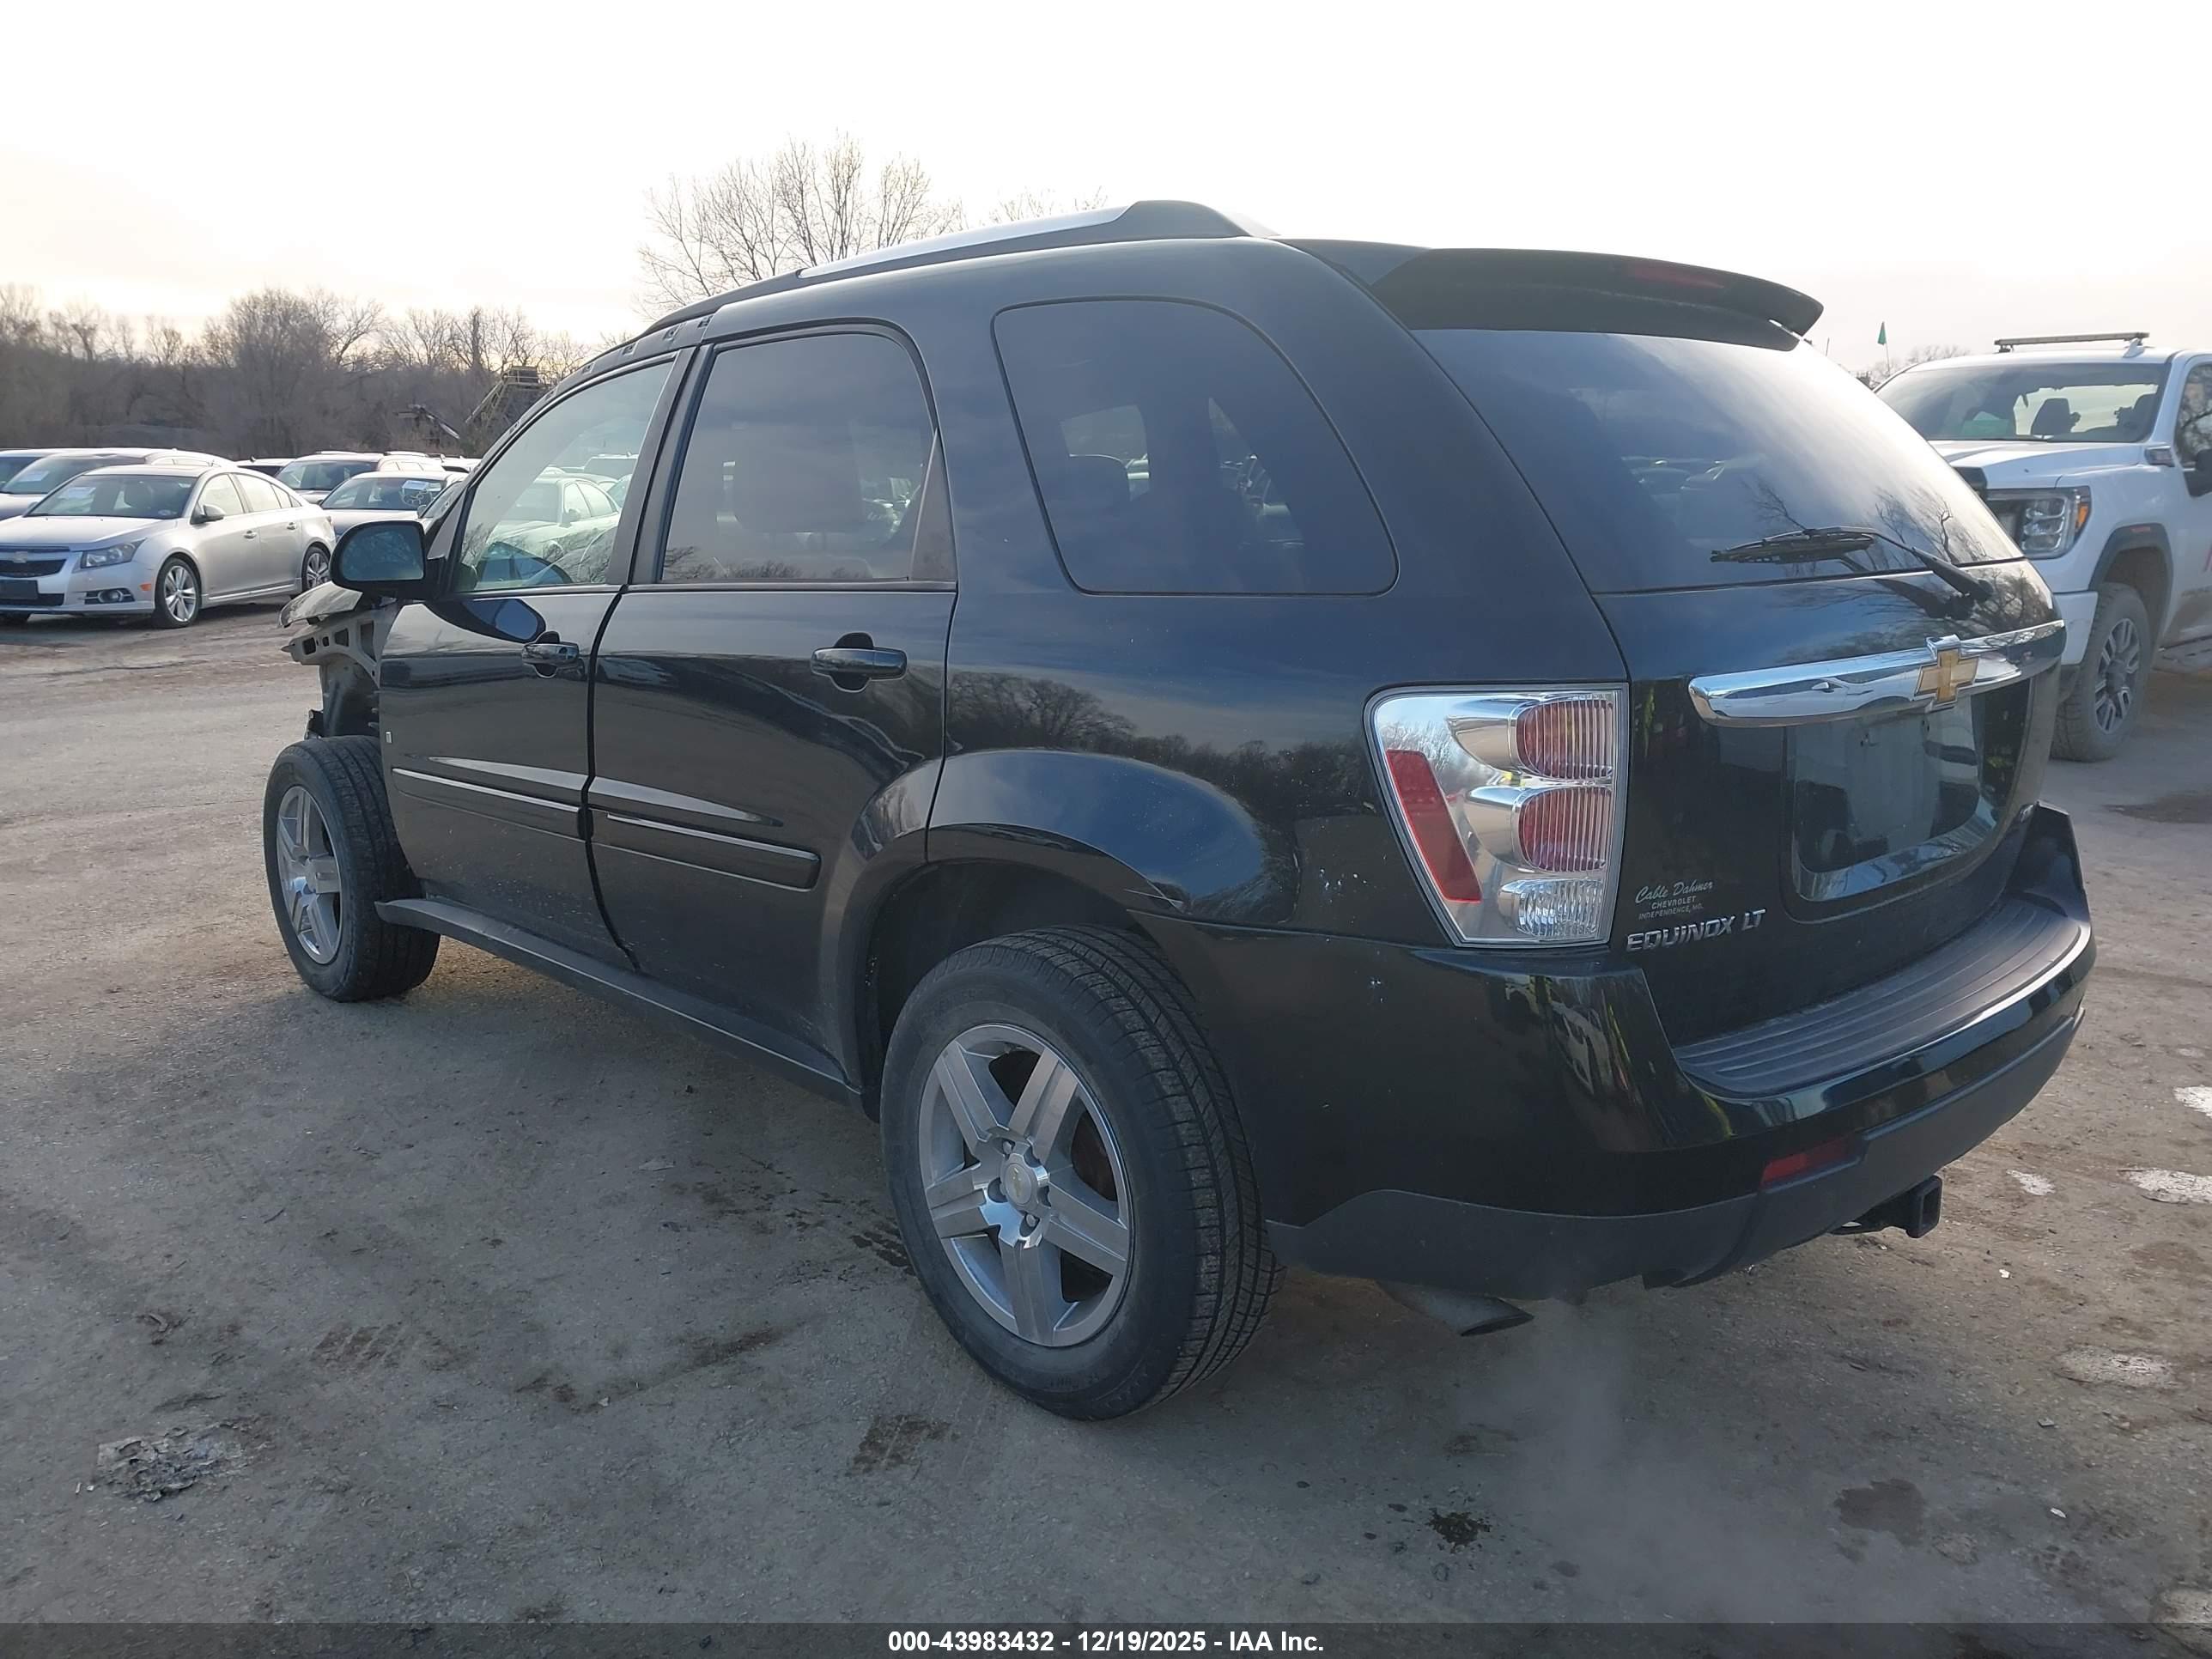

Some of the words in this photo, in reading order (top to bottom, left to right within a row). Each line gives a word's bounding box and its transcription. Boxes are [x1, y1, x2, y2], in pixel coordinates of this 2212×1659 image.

[1635, 885, 1668, 903] Cable
[1673, 879, 1714, 896] Dahmer
[1651, 896, 1697, 909] CHEVROLET
[1626, 915, 1735, 951] EQUINOX
[1741, 908, 1766, 931] LT
